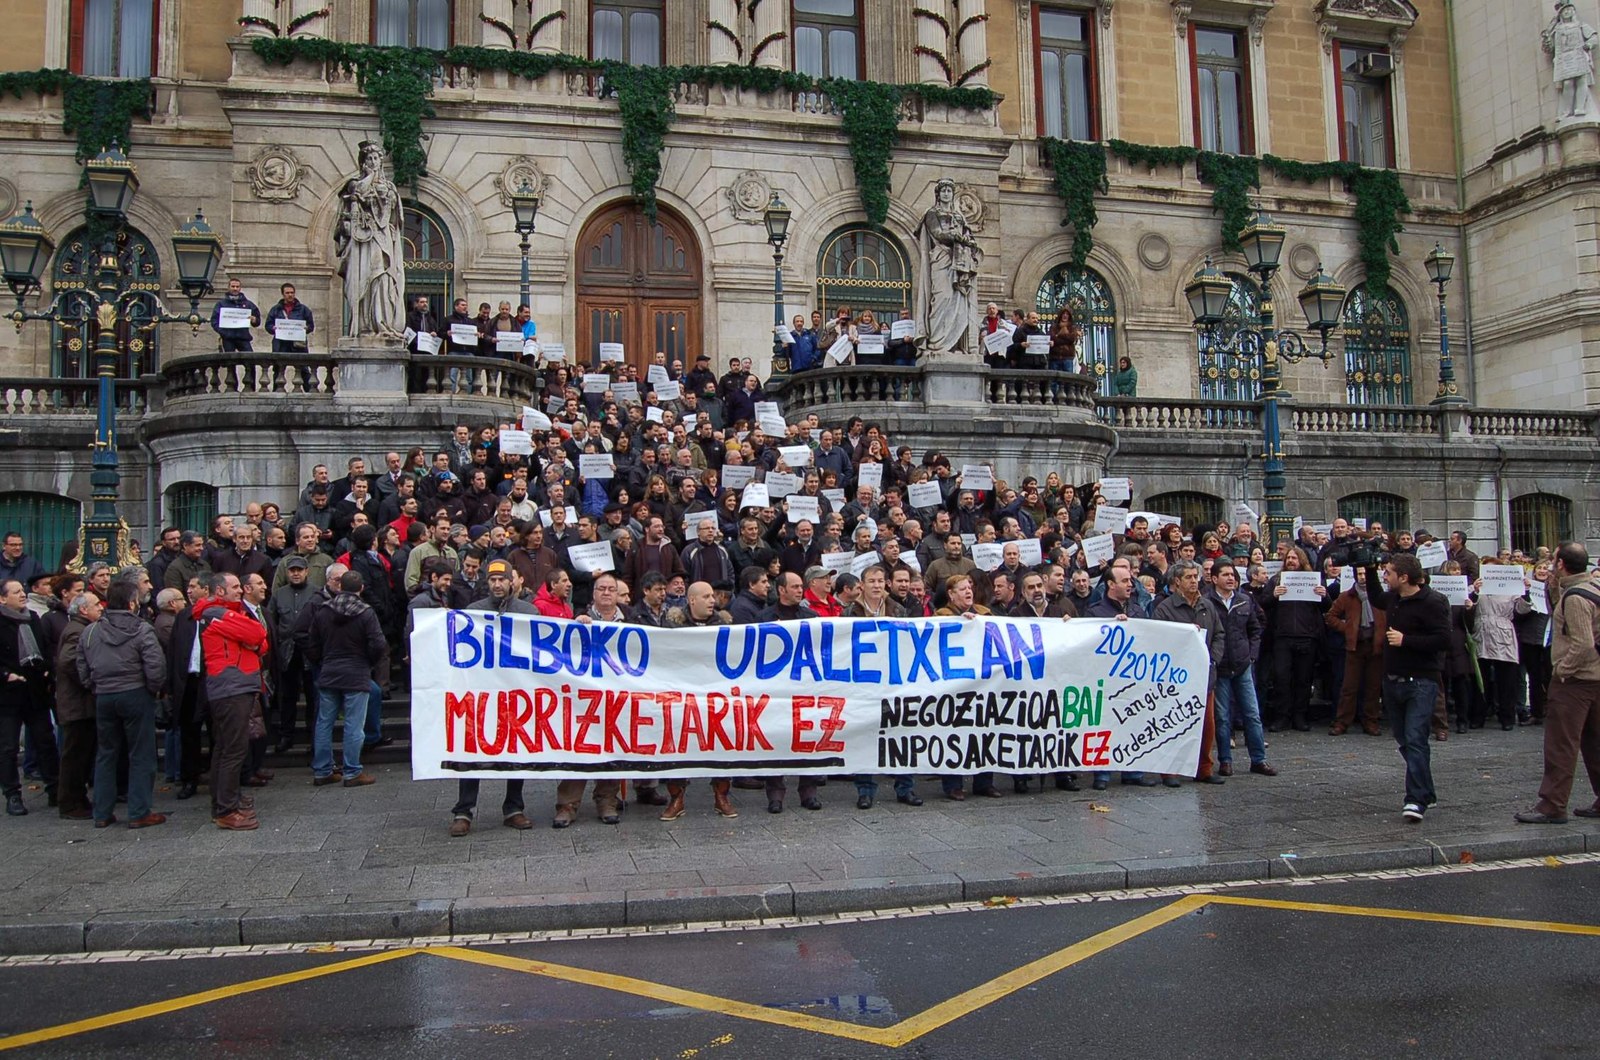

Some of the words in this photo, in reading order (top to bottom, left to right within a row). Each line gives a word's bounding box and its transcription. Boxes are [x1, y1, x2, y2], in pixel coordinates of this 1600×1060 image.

[716, 620, 1046, 686] UDALETXEAN
[791, 695, 846, 753] EZ
[1112, 683, 1180, 725] Langile
[1081, 731, 1112, 766] EZ
